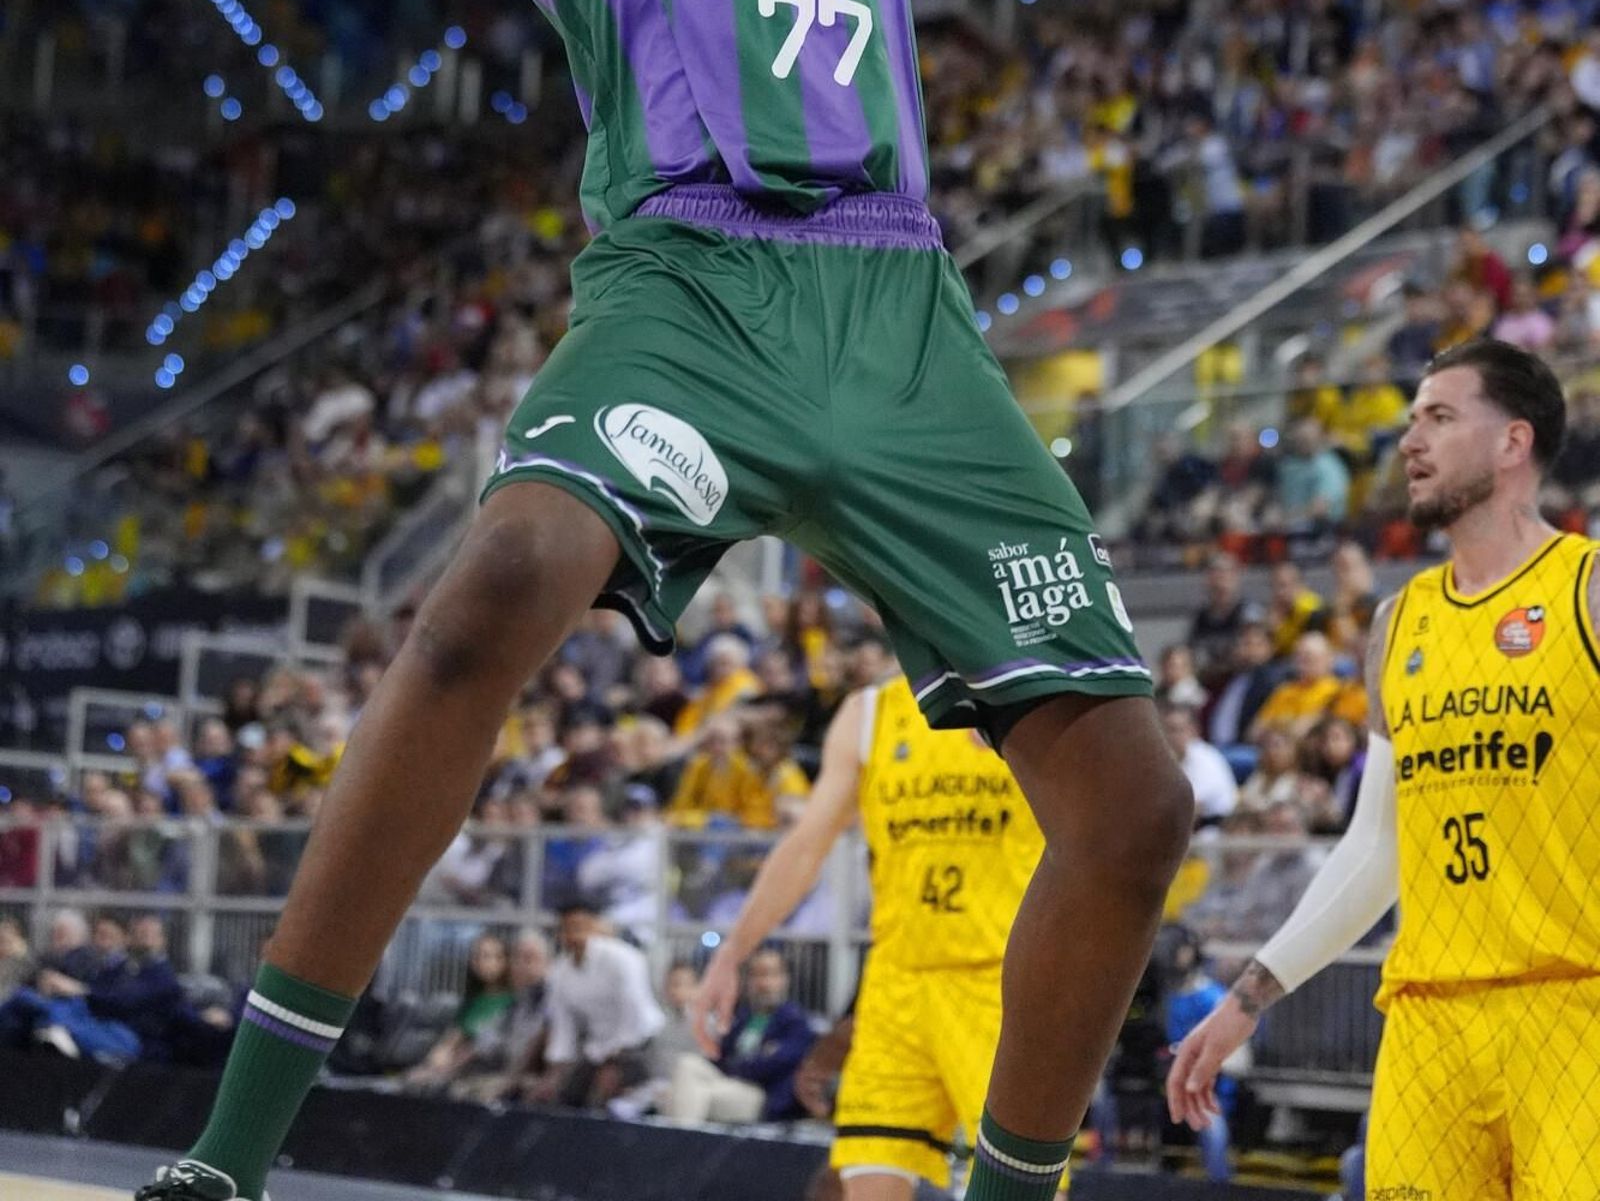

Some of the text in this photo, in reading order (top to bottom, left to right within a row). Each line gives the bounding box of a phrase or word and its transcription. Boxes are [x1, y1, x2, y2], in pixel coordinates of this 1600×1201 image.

[988, 542, 1029, 561] sabor
[993, 562, 1008, 579] a
[1420, 684, 1556, 722] LAGUNA
[1395, 730, 1555, 787] enerife!
[1443, 813, 1490, 886] 35
[921, 865, 967, 915] 42
